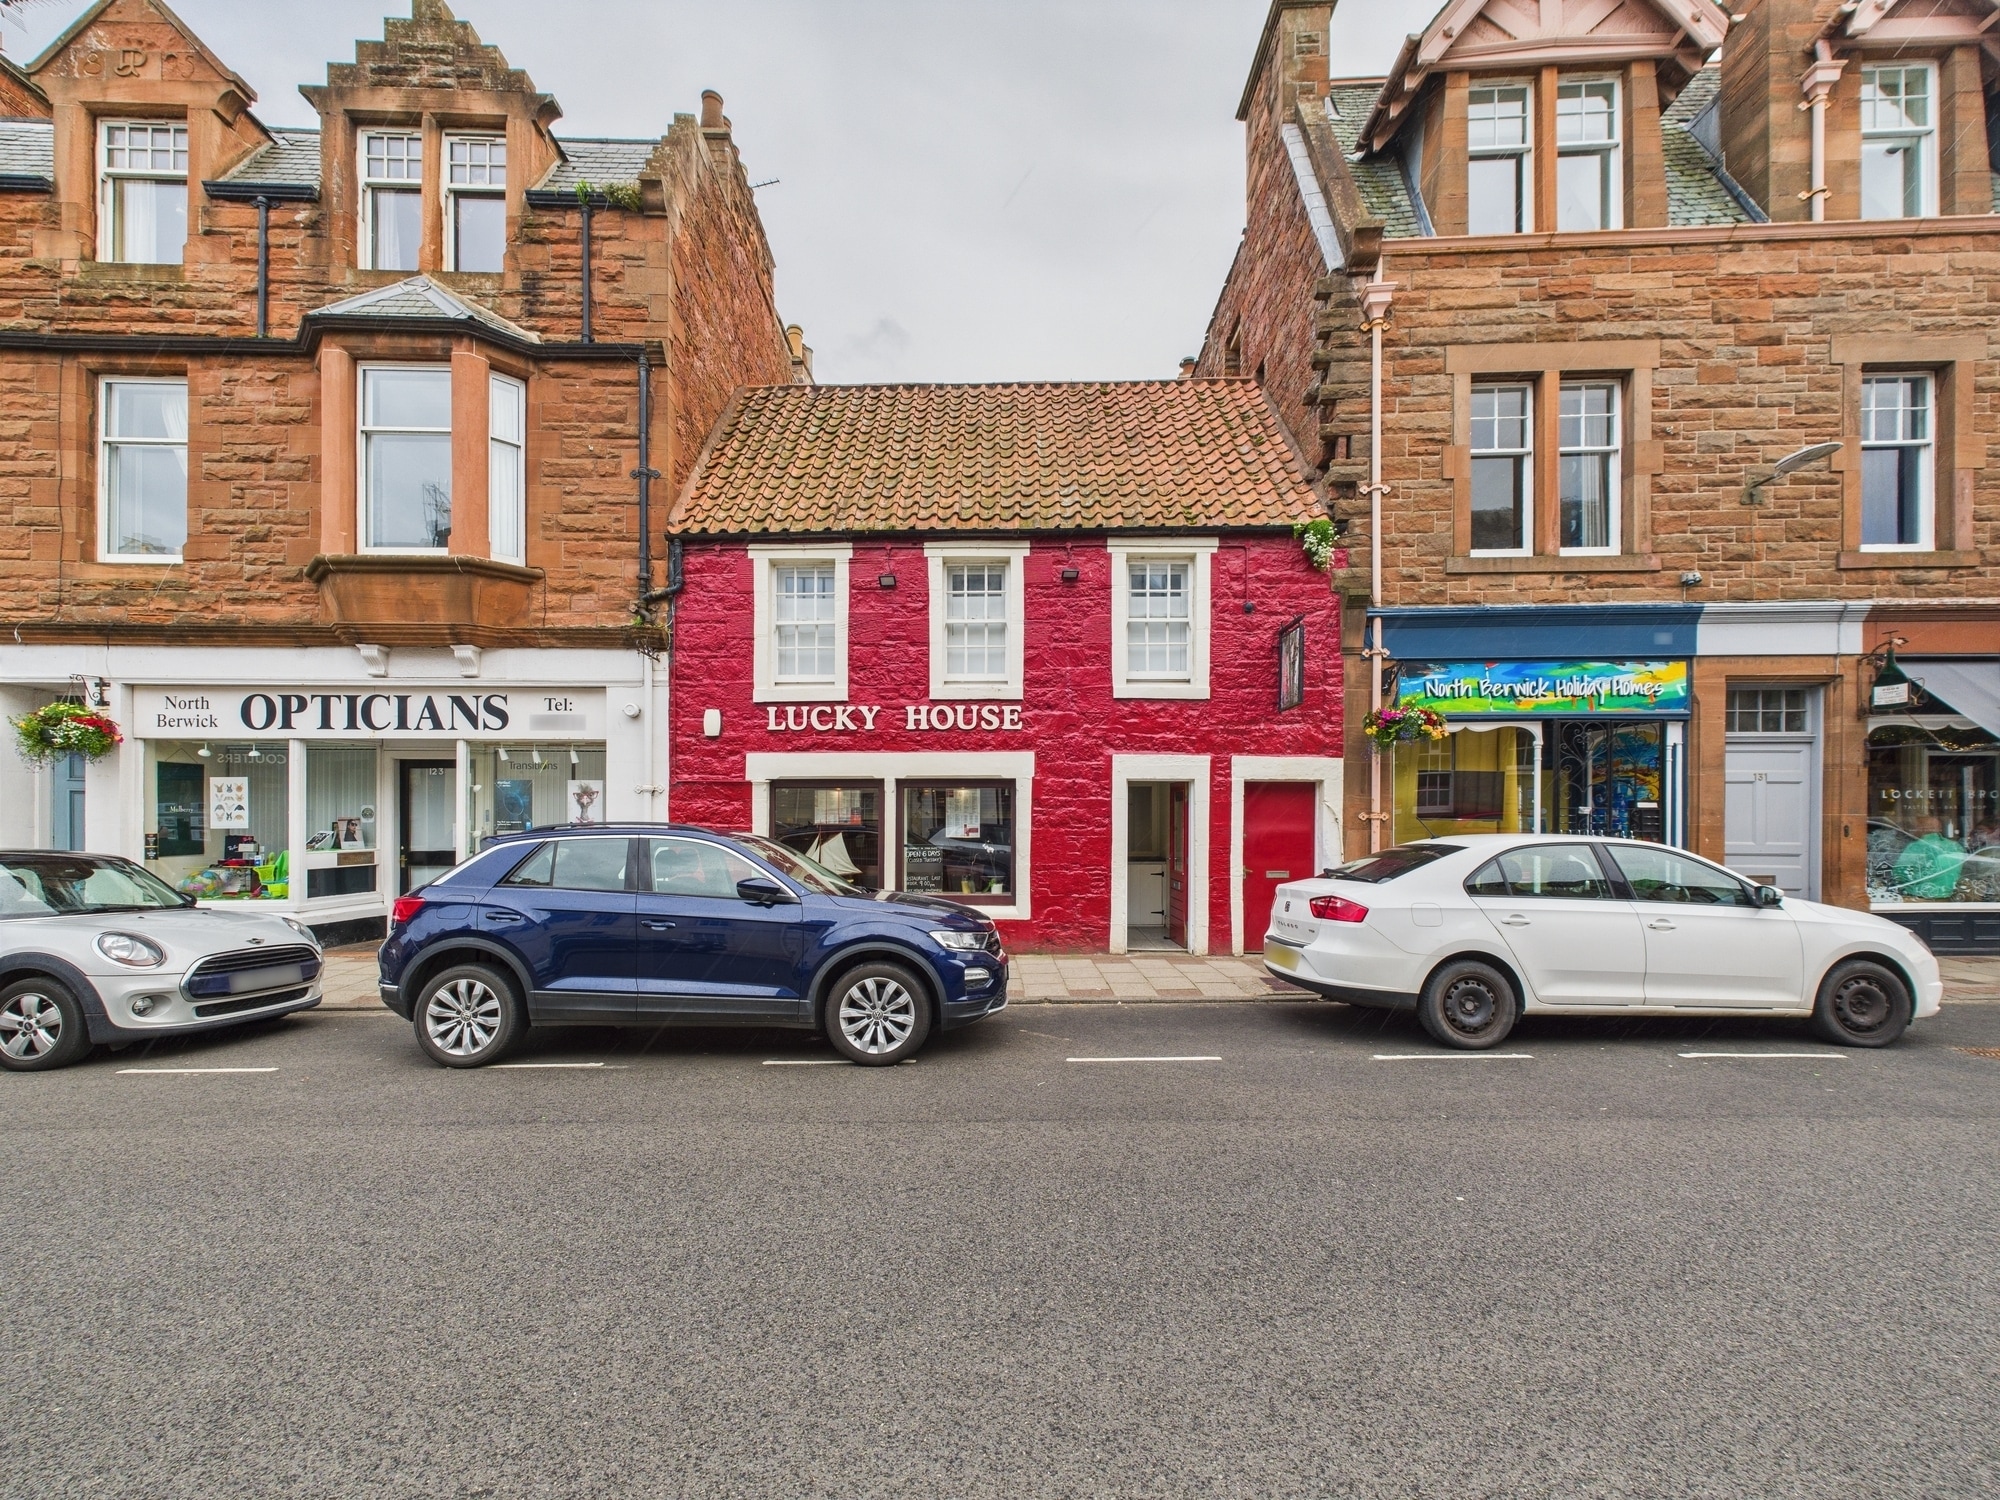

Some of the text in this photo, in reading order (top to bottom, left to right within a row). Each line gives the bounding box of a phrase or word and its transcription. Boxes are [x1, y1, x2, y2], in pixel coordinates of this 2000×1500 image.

[1424, 675, 1665, 706] North Berwick Holiday Homes
[164, 695, 210, 710] North
[544, 697, 573, 712] Tel:
[240, 694, 509, 731] OPTICIANS
[766, 705, 1023, 731] LUCKY HOUSE
[157, 713, 219, 728] Berwick
[429, 767, 444, 776] 123
[510, 760, 558, 771] Transitions
[1753, 773, 1768, 782] 131
[1881, 789, 1954, 799] LOCKETT
